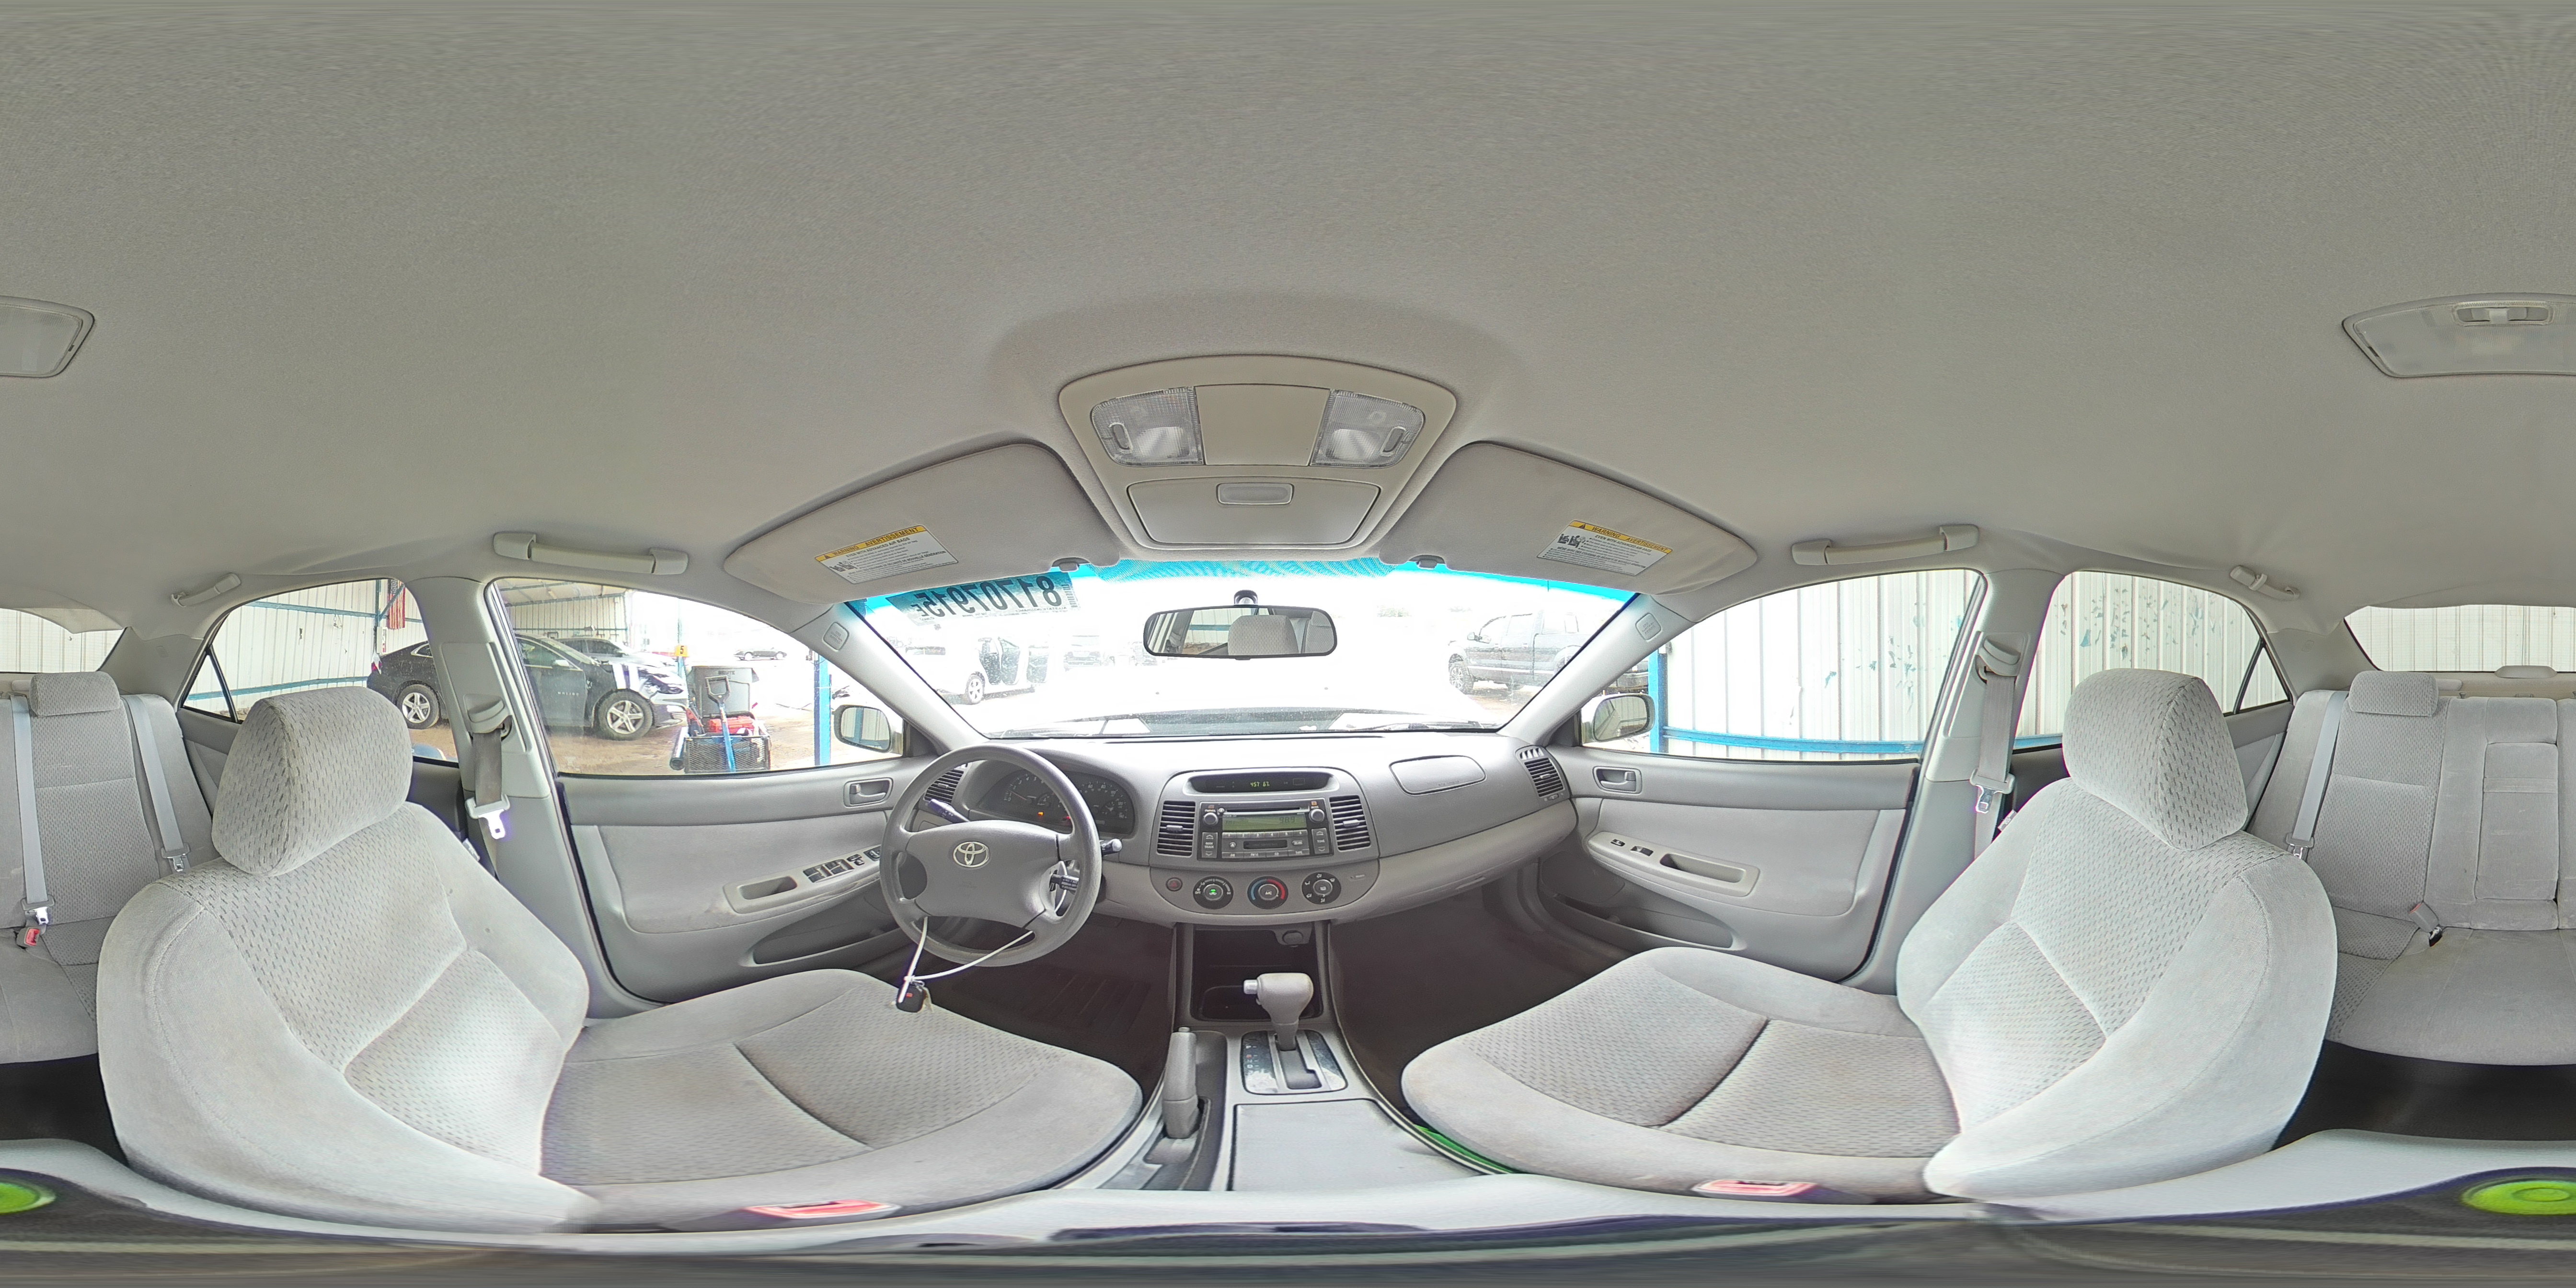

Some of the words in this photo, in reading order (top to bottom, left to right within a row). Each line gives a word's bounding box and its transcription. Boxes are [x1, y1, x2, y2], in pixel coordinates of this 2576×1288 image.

[832, 545, 860, 555] WARNING
[865, 527, 919, 547] AVERTISSEMENT
[1590, 526, 1622, 538] WARNING
[1625, 537, 1668, 551] AVERTISSEMENT
[865, 543, 889, 552] ADVANCED
[680, 645, 684, 655] 5
